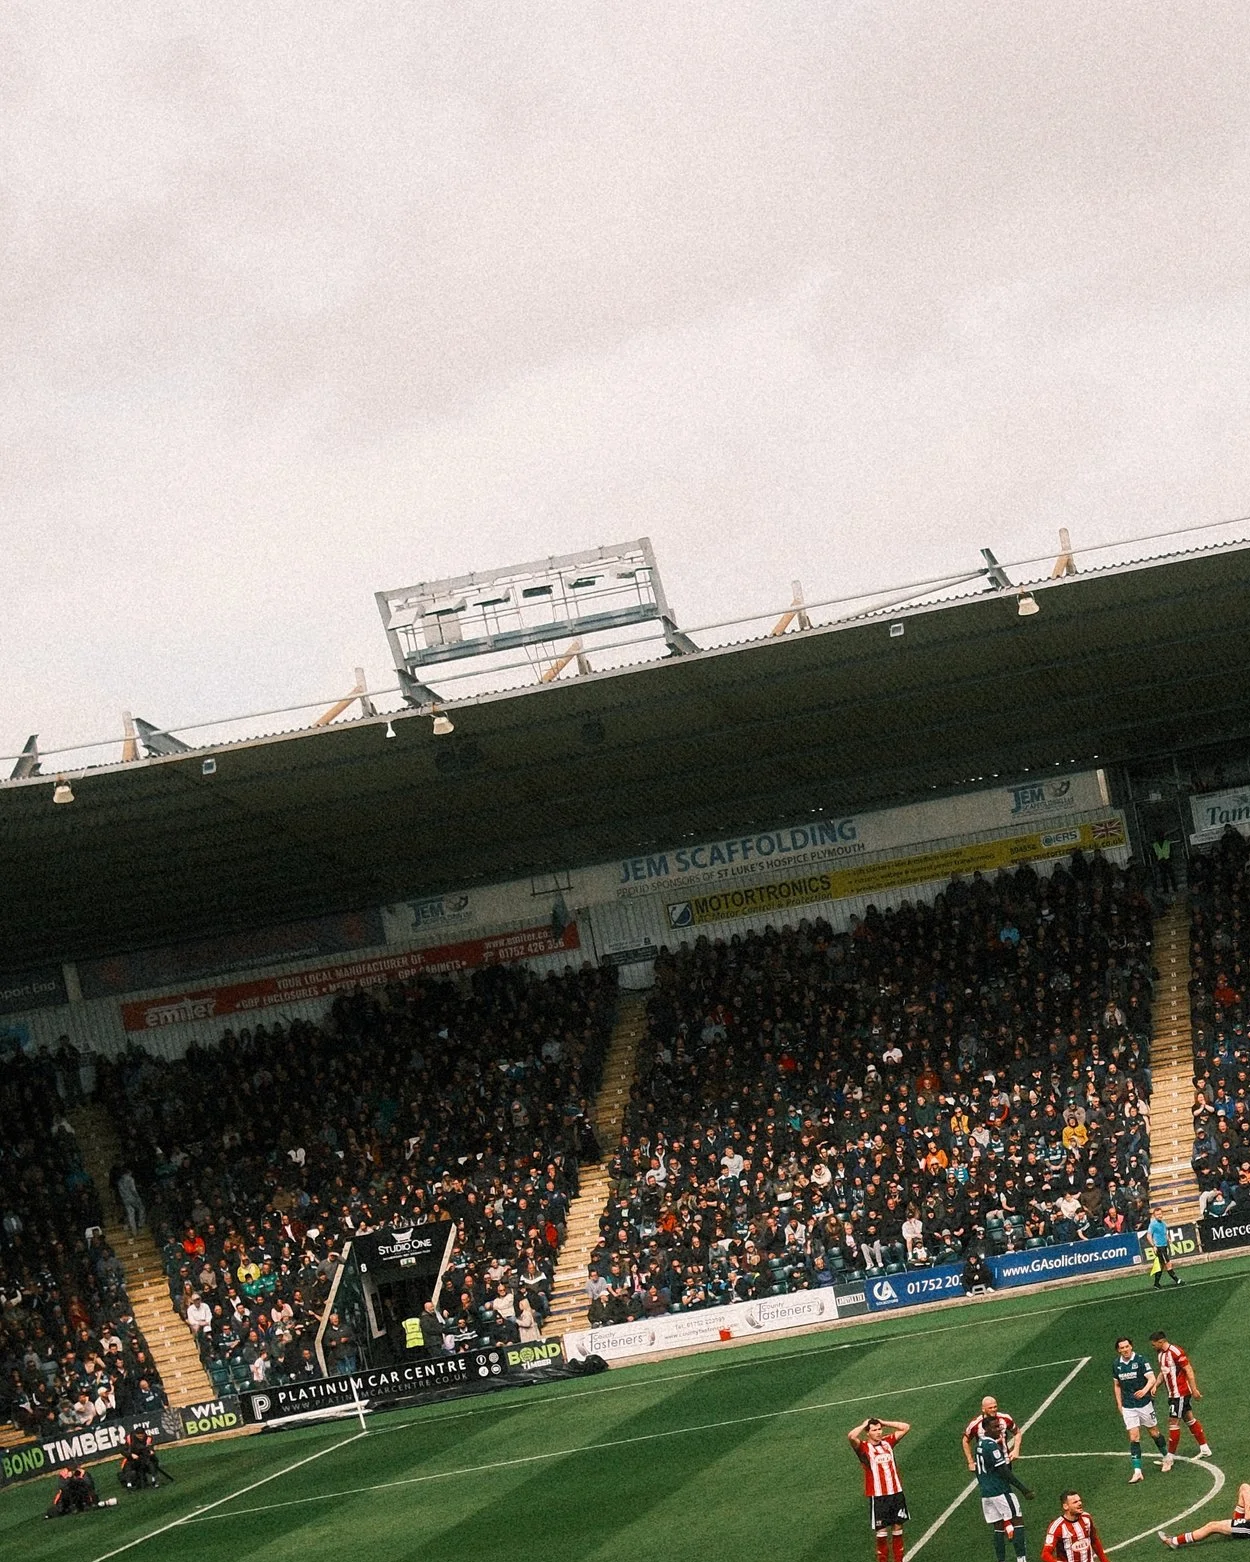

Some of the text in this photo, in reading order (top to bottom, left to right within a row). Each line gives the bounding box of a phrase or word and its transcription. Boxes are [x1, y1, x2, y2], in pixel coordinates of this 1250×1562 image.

[620, 855, 669, 884] JEM
[675, 819, 859, 873] SCAFFOLDING
[616, 842, 866, 898] PROUD SPONSORS OF ST LUKE'S HOSPICE PLYMOUTH
[694, 874, 832, 915] MOTORTRONICS
[276, 977, 302, 991] YOUR
[303, 970, 333, 986] LOCAL
[335, 957, 409, 980] MANUFACTURER
[378, 1242, 411, 1256] STUDIO
[412, 1238, 433, 1249] ONE
[1144, 1239, 1196, 1261] BND
[360, 1263, 368, 1273] 8
[906, 1277, 942, 1295] 01752
[1002, 1245, 1128, 1278] www.GAsolicitors.com
[757, 1301, 812, 1322] Fasteners
[589, 1331, 644, 1352] Fasteners
[507, 1343, 561, 1366] BOND
[278, 1359, 468, 1404] PLATINUM CAR CENTRE
[190, 1401, 225, 1418] WH
[185, 1412, 237, 1435] BOND
[2, 1424, 126, 1479] BOND TIMBER
